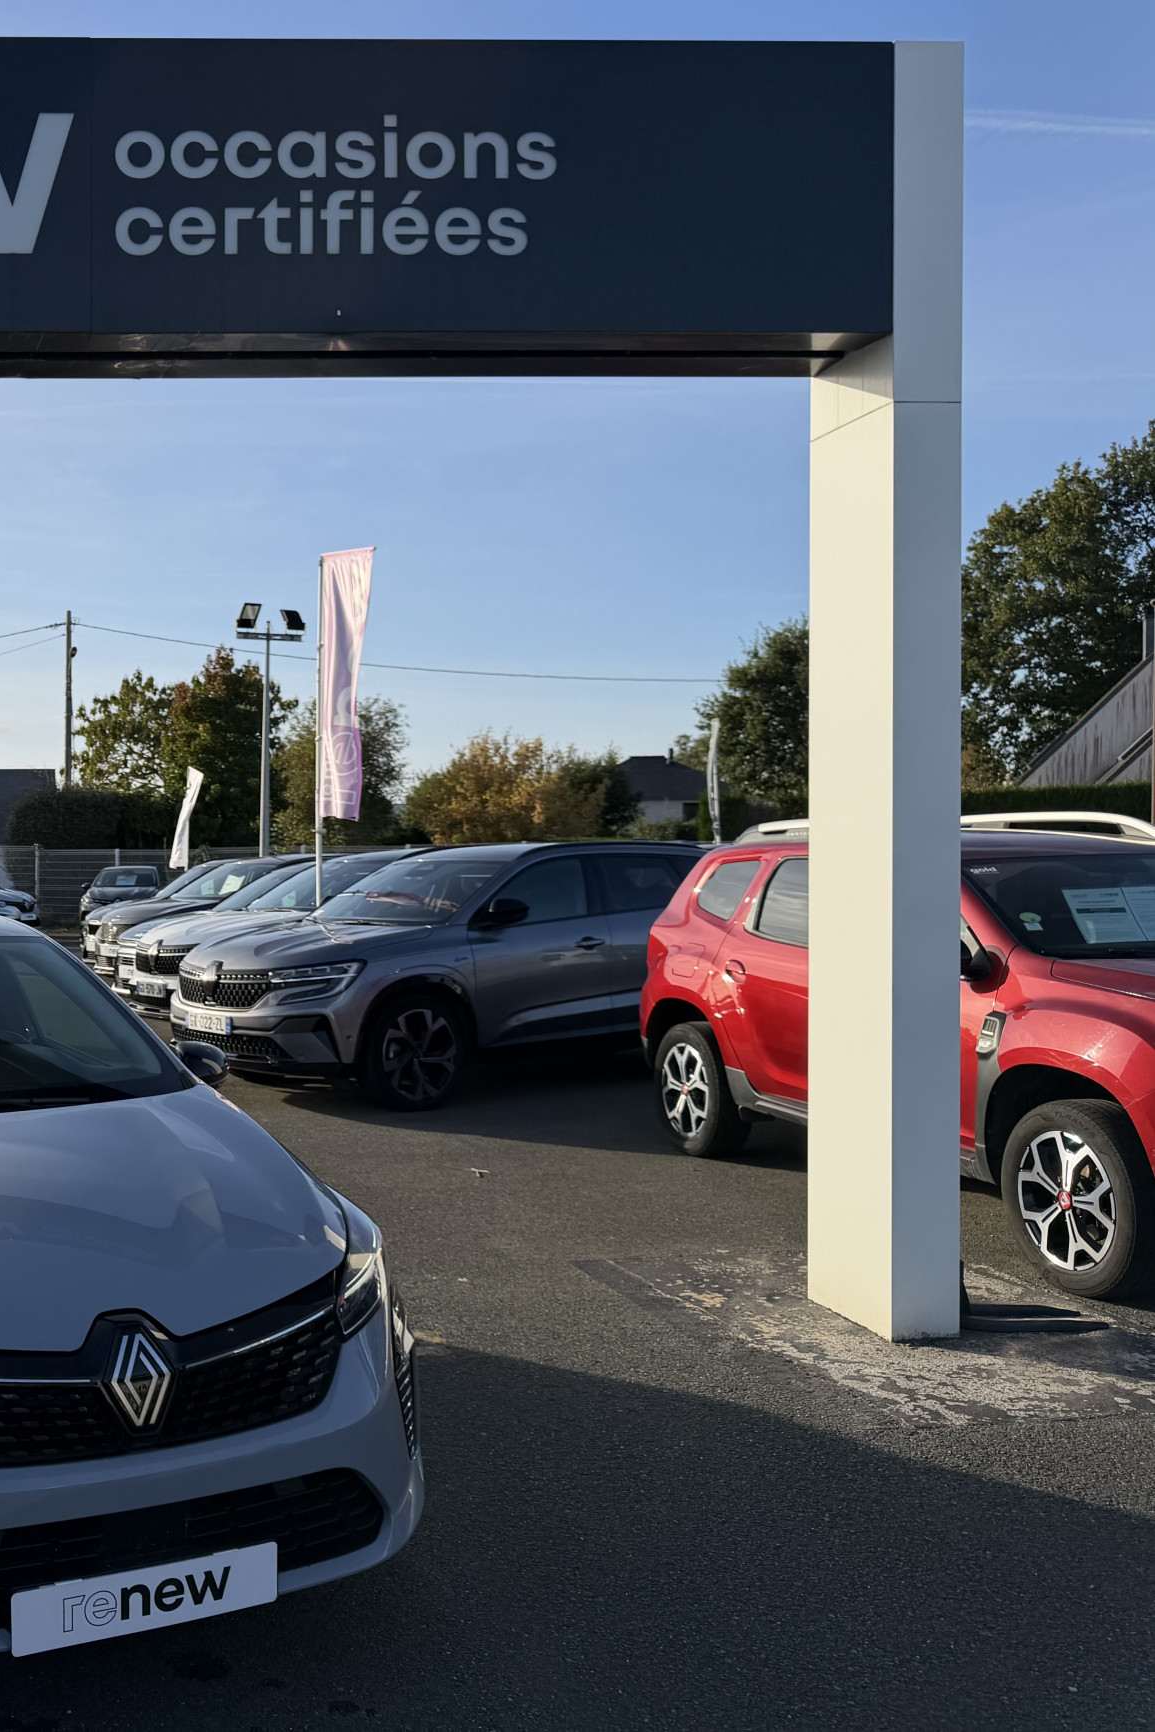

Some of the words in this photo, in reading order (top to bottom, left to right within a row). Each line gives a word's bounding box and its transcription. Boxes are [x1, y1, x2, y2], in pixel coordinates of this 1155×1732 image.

[114, 114, 557, 180] occasions
[115, 189, 528, 256] certifiées
[62, 1565, 231, 1633] renew
